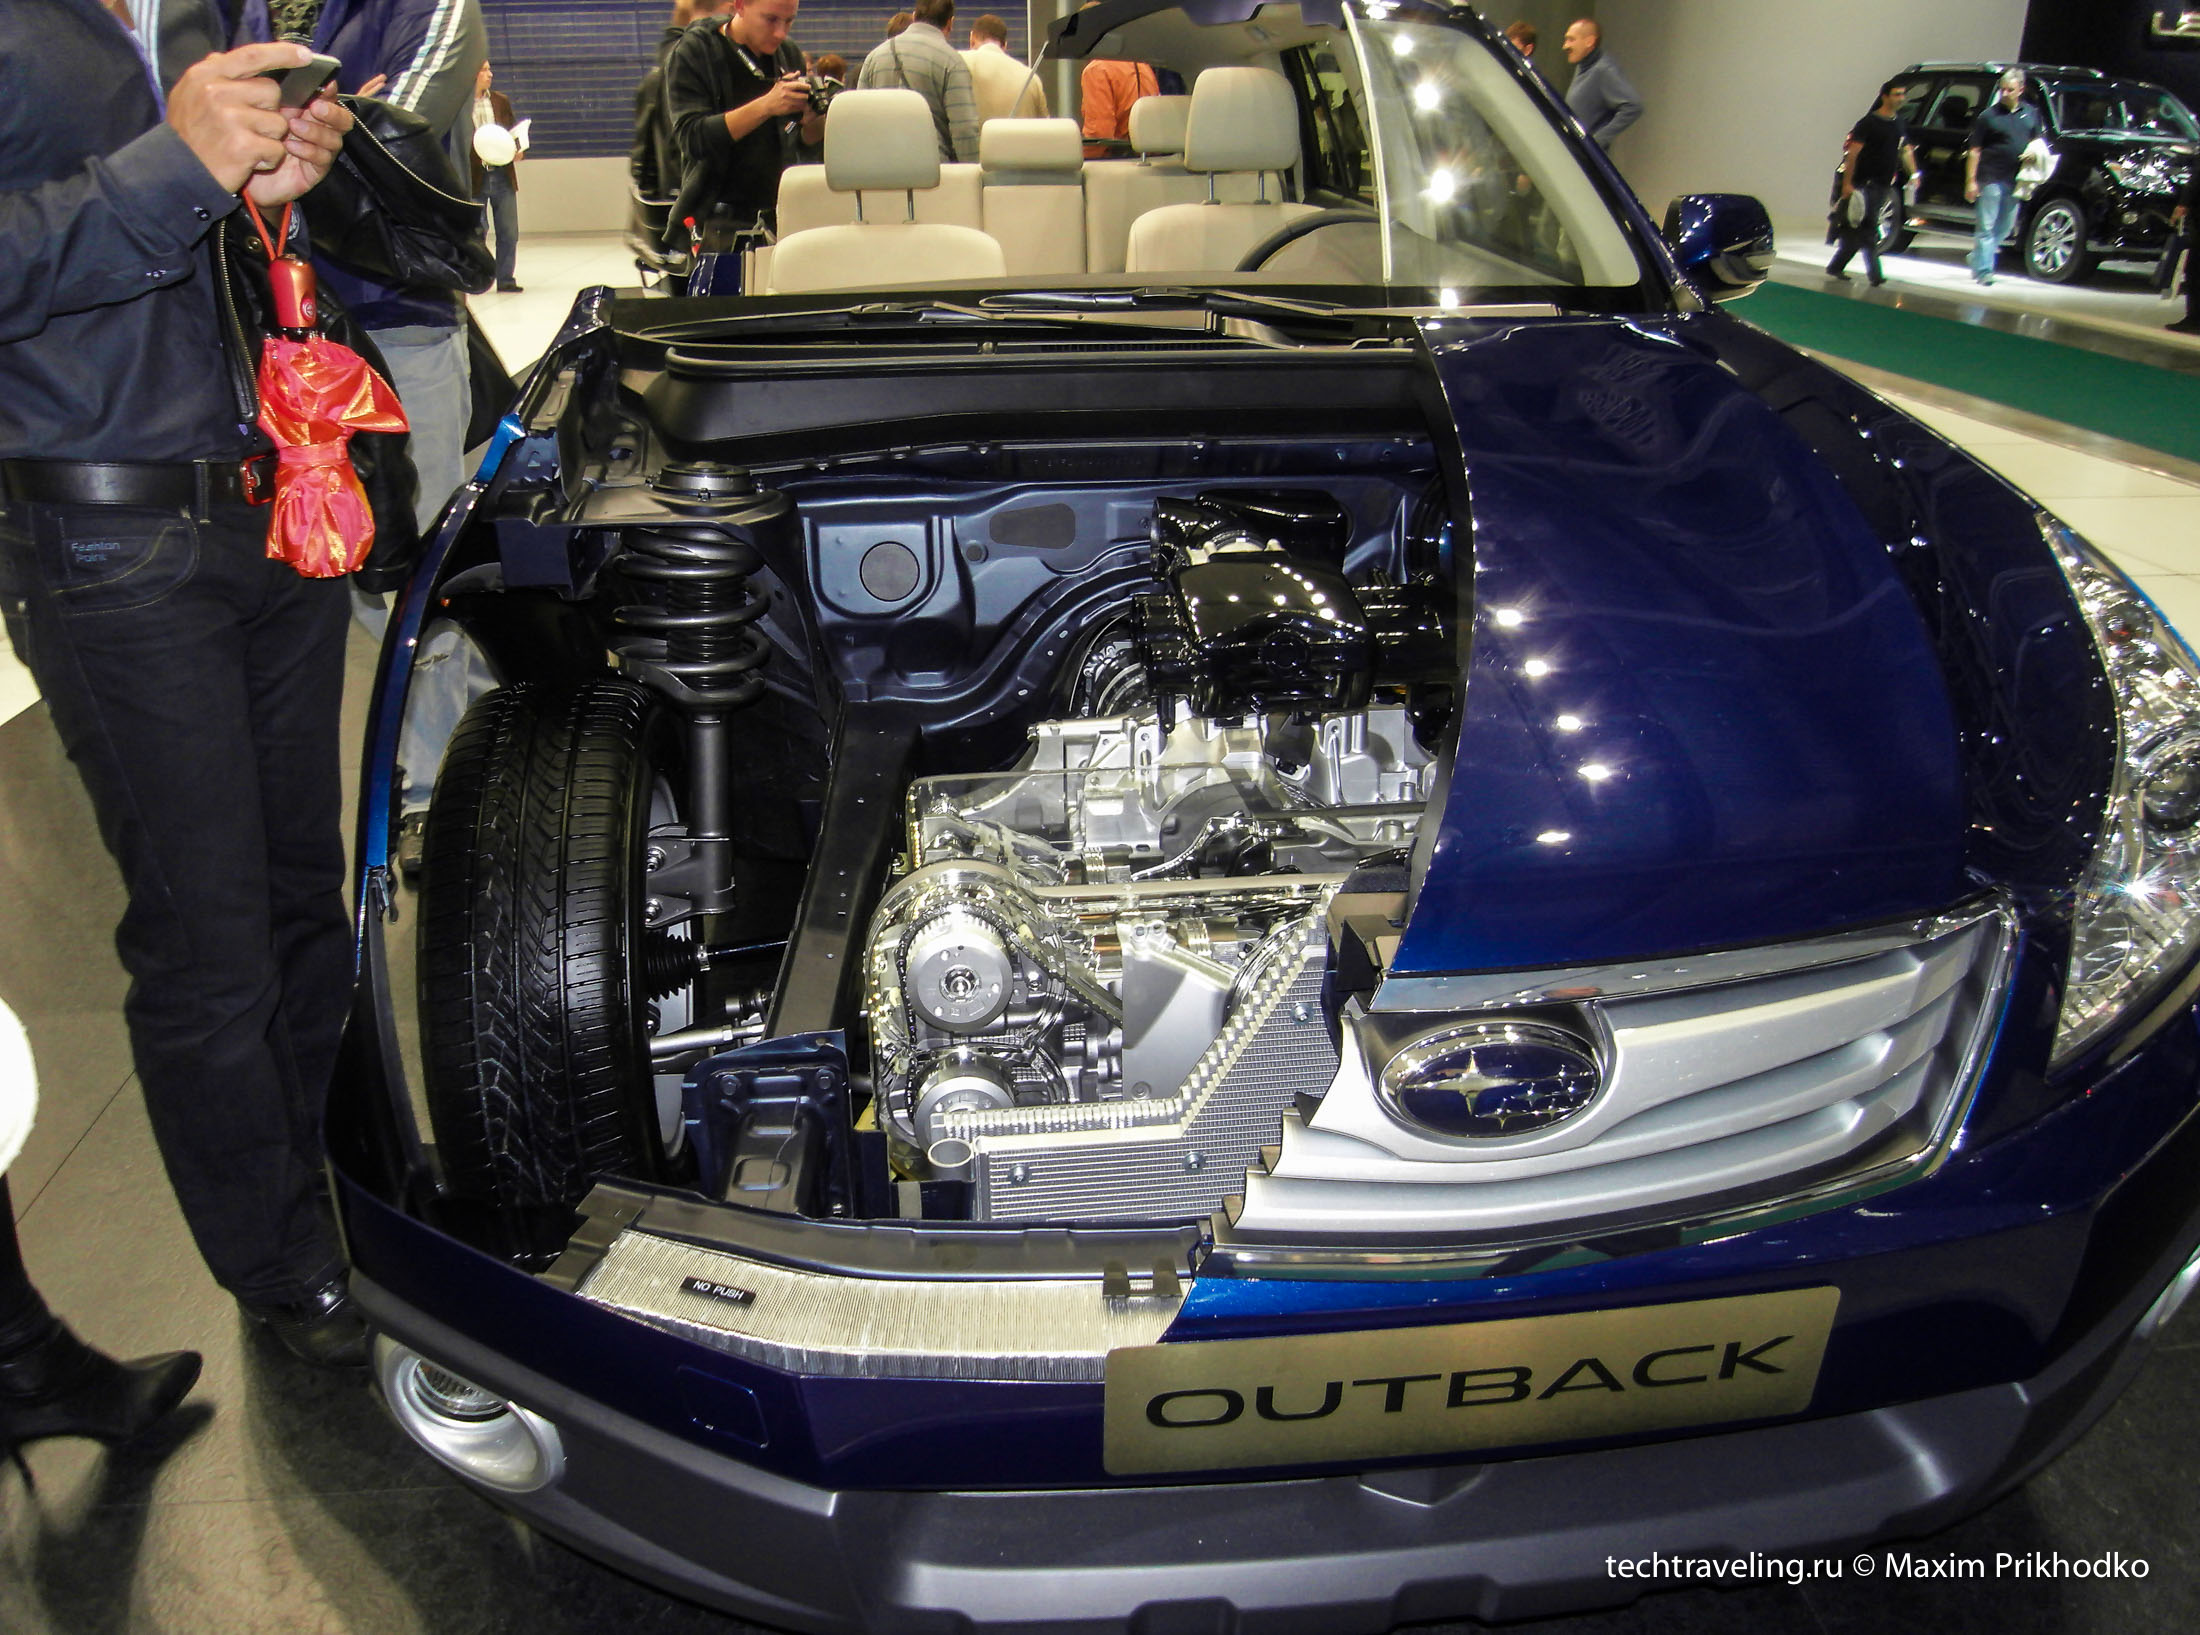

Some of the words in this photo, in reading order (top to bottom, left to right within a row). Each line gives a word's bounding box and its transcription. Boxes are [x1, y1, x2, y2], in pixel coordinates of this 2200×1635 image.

[692, 1280, 711, 1292] NO
[713, 1285, 744, 1300] PUSH
[1146, 1335, 1795, 1430] OUTBACK
